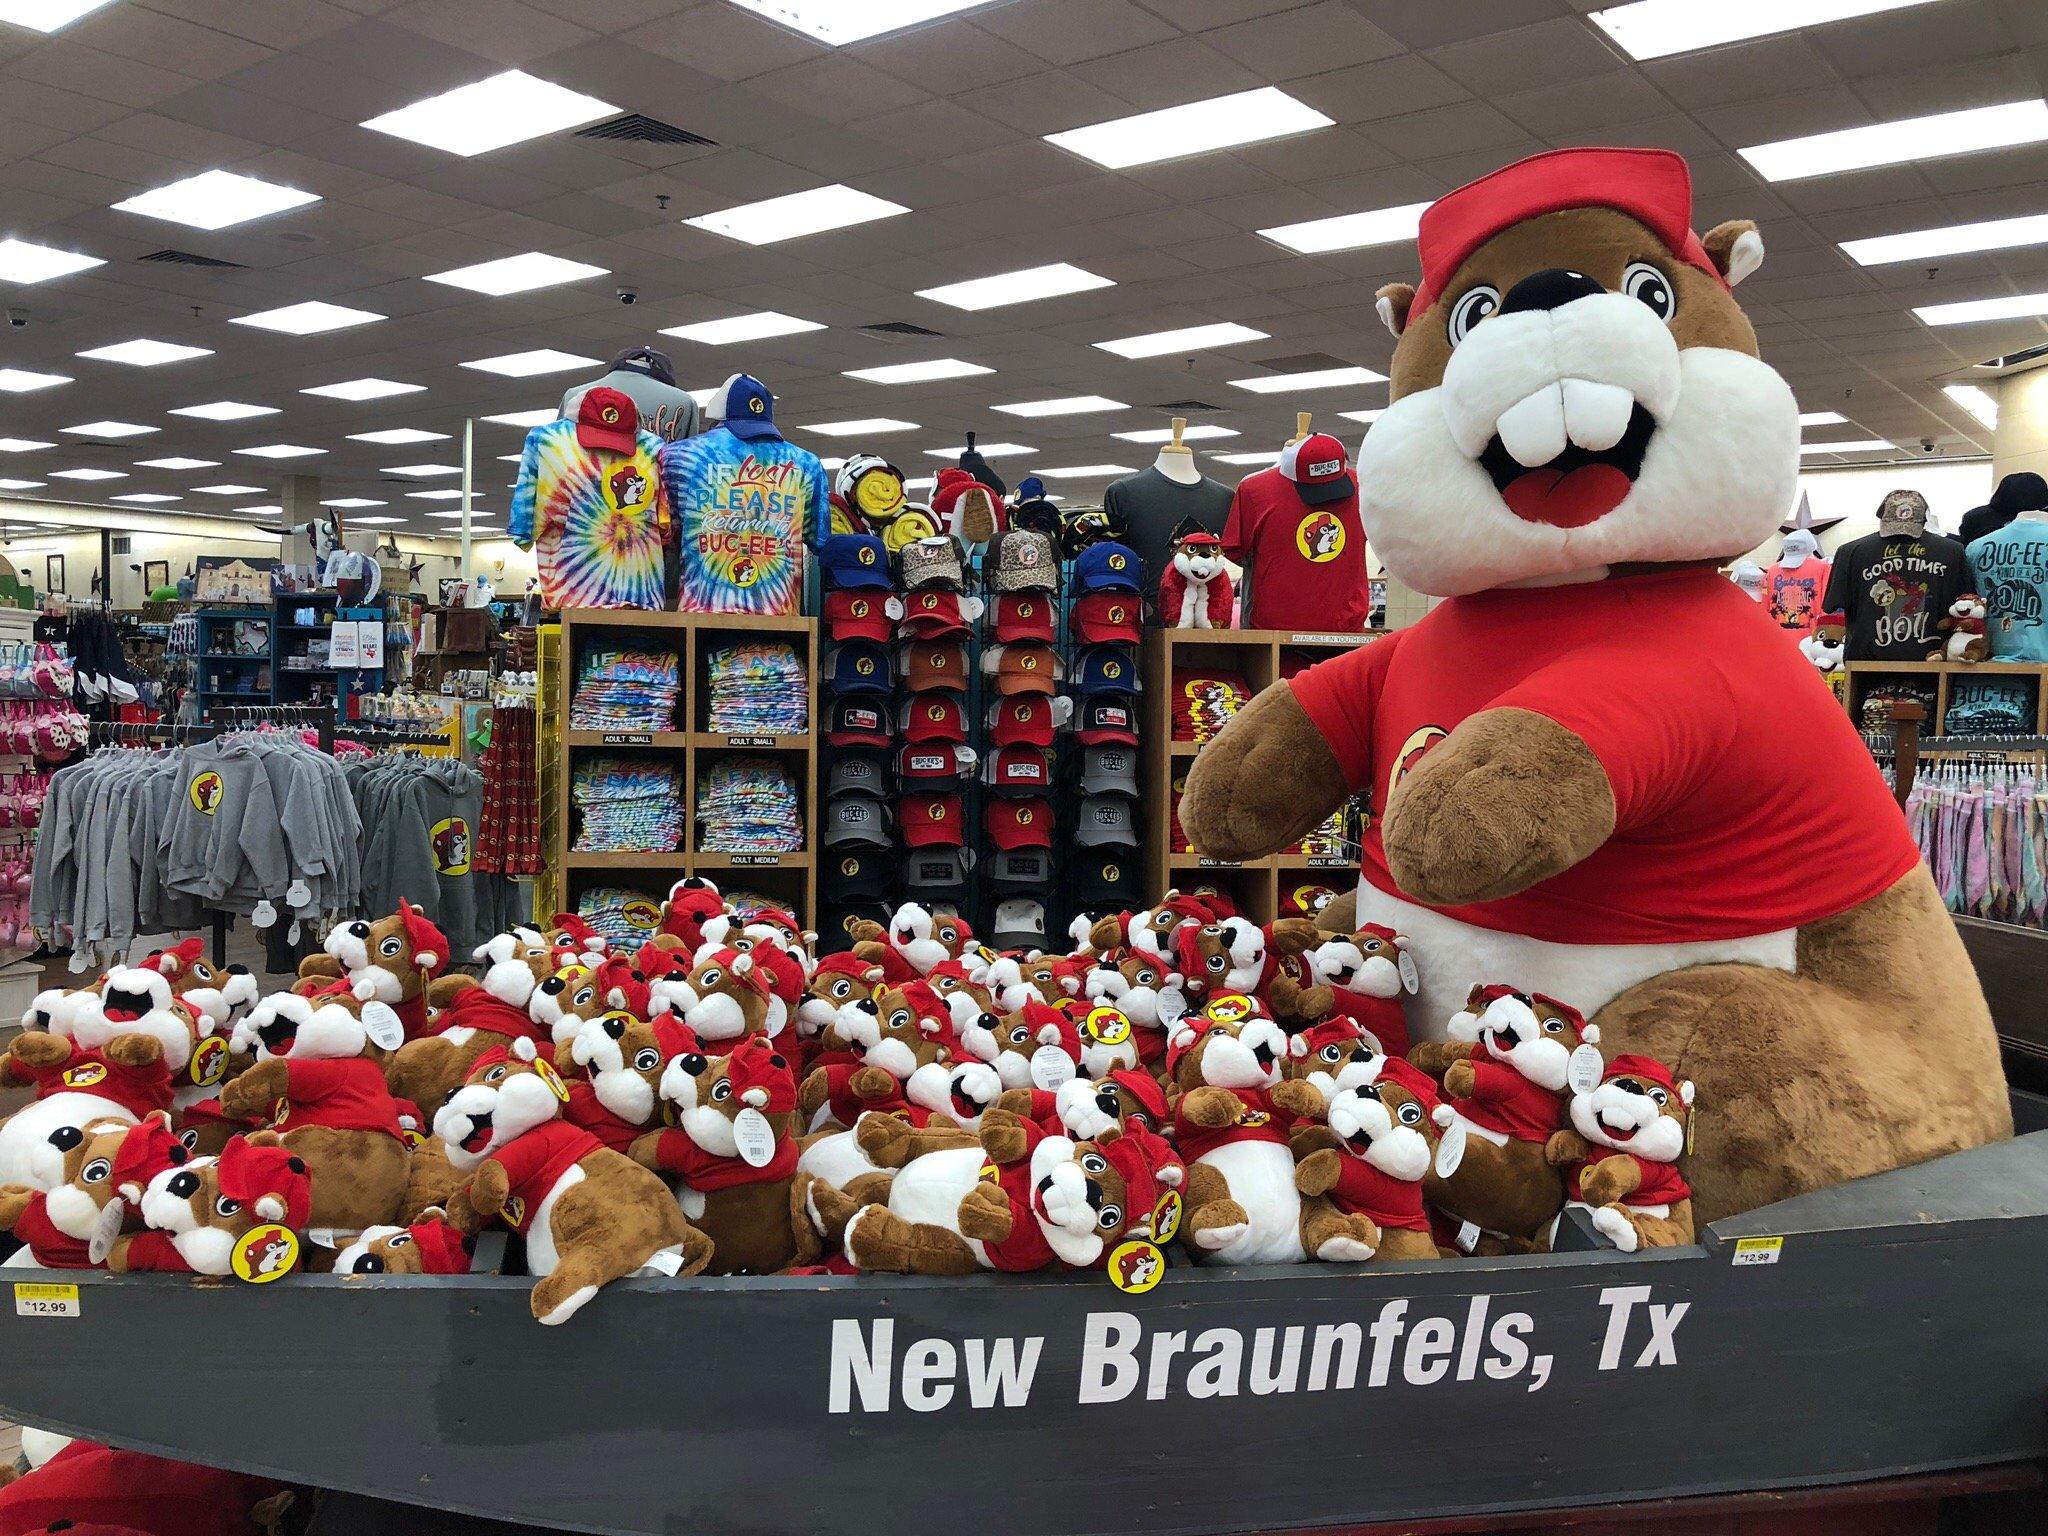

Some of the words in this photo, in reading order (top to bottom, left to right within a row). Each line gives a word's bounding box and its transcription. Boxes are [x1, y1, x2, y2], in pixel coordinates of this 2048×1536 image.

[707, 464, 731, 485] IF
[695, 488, 797, 517] PLEASE
[700, 510, 770, 536] Return
[698, 533, 797, 559] BUC-EE'S
[1908, 543, 1928, 557] the
[1862, 558, 1904, 581] GOOD
[1906, 557, 1947, 577] TIMES
[1874, 612, 1941, 648] BOIL
[604, 735, 626, 744] ADULT
[629, 735, 651, 744] SMALL
[729, 738, 750, 746] ADULT
[753, 738, 774, 746] SMALL
[731, 856, 751, 864] ADULT
[754, 856, 779, 864] MEDIUM
[1308, 858, 1327, 866] ADULT
[1328, 858, 1349, 866] MEDIUM
[829, 1318, 1045, 1413] New
[1078, 1294, 1554, 1404] Braunfels,
[1598, 1285, 1691, 1371] Tx
